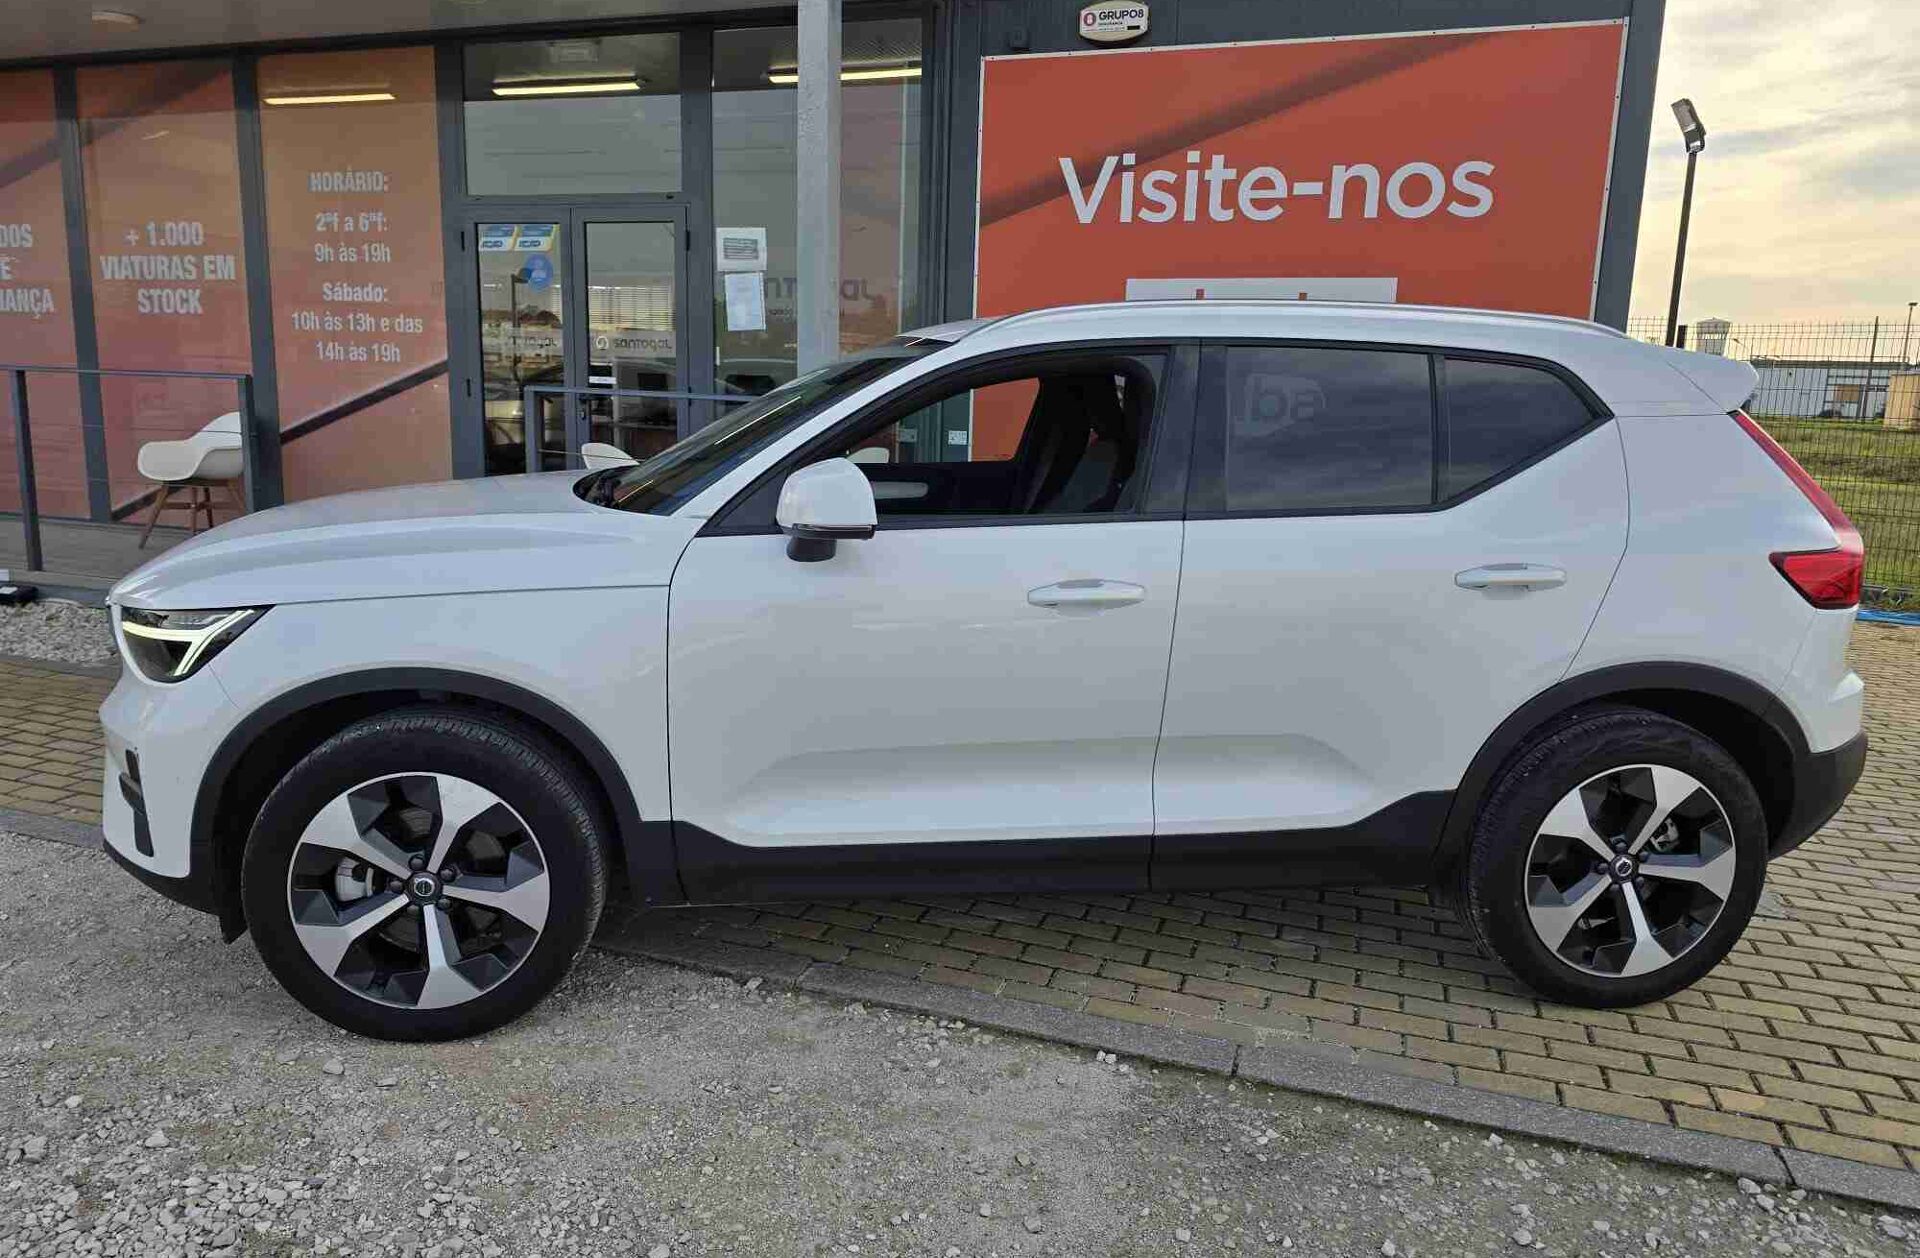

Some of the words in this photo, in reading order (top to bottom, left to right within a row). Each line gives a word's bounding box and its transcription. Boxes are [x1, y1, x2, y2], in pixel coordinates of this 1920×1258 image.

[1098, 9, 1144, 20] GRUPO8
[310, 165, 389, 192] HORÁRIO:
[1059, 150, 1495, 224] Visite-nos
[147, 221, 204, 246] 1.000
[344, 217, 355, 232] a
[314, 242, 334, 262] 9h
[339, 242, 357, 262] às
[361, 243, 391, 263] 19h
[101, 255, 197, 280] VIATURAS
[203, 254, 236, 280] EM
[137, 288, 204, 314] STOCK
[322, 282, 388, 301] Sábado:
[291, 310, 320, 331] 10h
[324, 311, 343, 331] às
[349, 312, 376, 332] 13h
[380, 317, 390, 331] e
[394, 313, 423, 333] das
[316, 341, 344, 361] 14h
[372, 342, 400, 363] 19h
